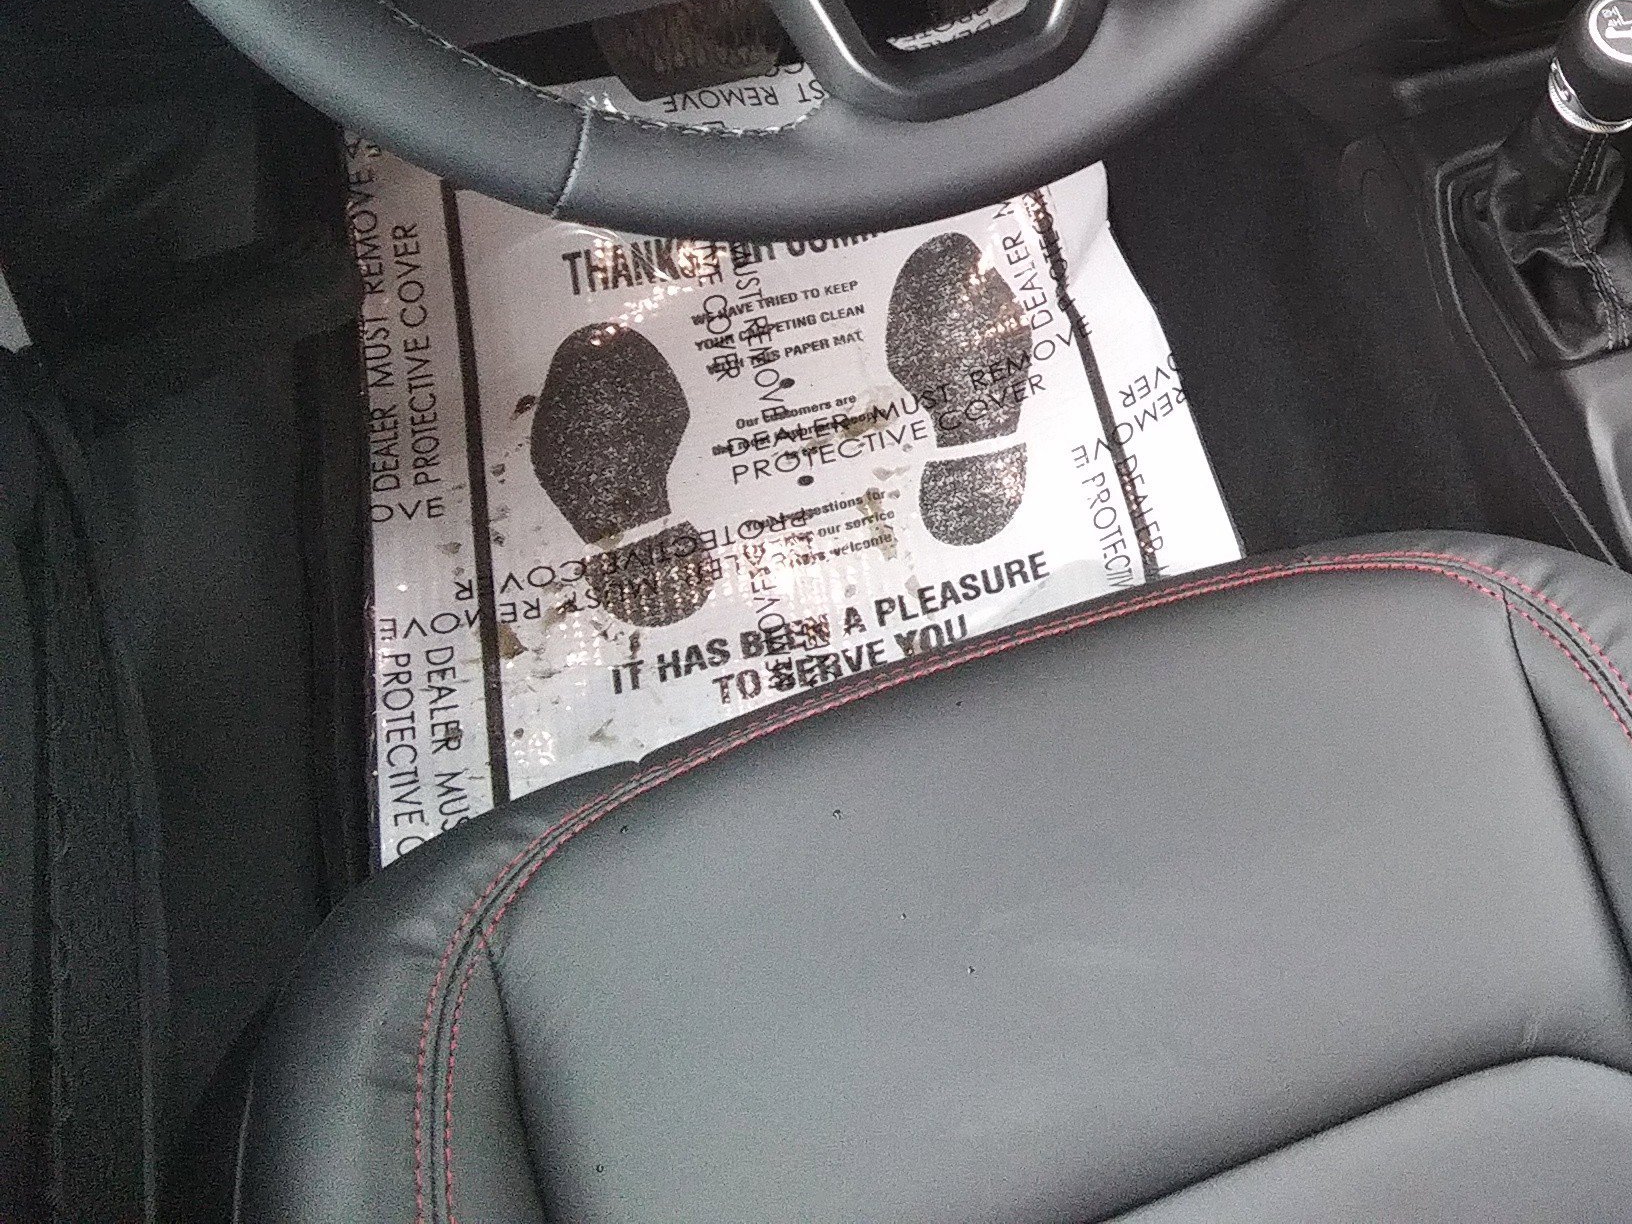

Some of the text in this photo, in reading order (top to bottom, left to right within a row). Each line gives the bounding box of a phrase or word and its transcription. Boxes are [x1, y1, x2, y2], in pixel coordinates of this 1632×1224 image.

[663, 86, 780, 114] REMOVE
[756, 292, 799, 313] TRIED
[800, 287, 821, 302] TO
[823, 279, 860, 297] KEEP
[819, 304, 866, 325] CLEAN
[1002, 229, 1055, 332] DEALER
[364, 316, 395, 390] MUST
[391, 222, 441, 487] PROTECTIVE COVER
[703, 294, 741, 383] COVER
[784, 338, 831, 359] PAPER
[732, 373, 1047, 485] PROTECTIVE COVER
[736, 415, 760, 430] Our
[835, 394, 858, 408] are
[869, 383, 952, 426] MUST
[370, 403, 401, 493] DEALER
[817, 509, 896, 538] our service
[865, 488, 887, 503] for
[611, 656, 646, 695] IT
[656, 637, 730, 684] HAS
[842, 606, 868, 637] A
[874, 550, 1051, 626] PLEASURE
[711, 669, 763, 705] TO
[893, 613, 970, 658] YOU
[381, 652, 426, 828] PROTECTIVE
[424, 645, 463, 755] DEALER
